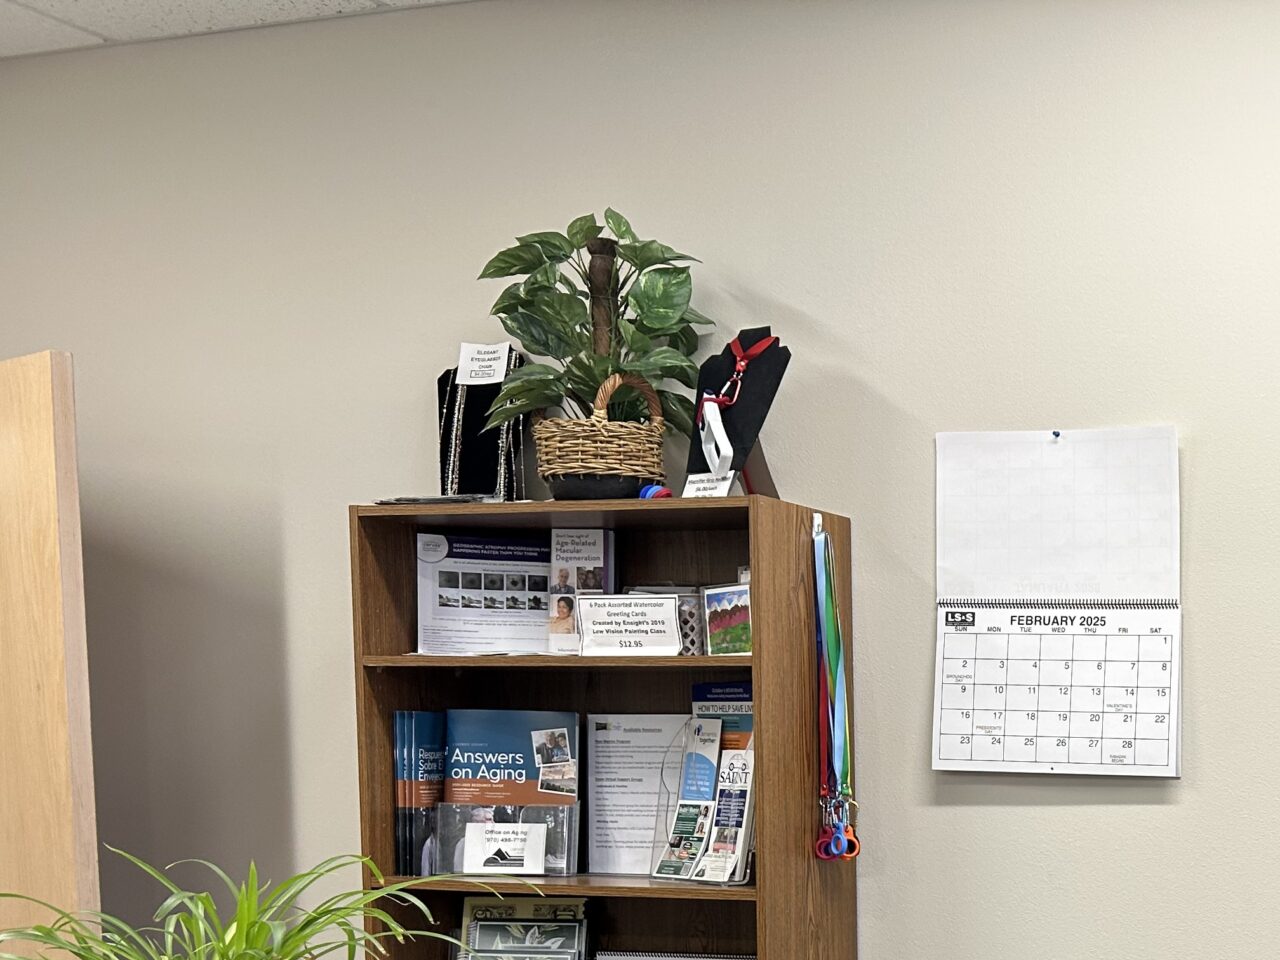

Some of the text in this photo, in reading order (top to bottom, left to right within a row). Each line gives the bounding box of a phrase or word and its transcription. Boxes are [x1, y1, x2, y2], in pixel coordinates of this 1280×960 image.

[1010, 616, 1106, 626] FEBRUARY 2025
[619, 640, 643, 648] $12.95
[1097, 662, 1102, 670] 6
[1161, 663, 1167, 671] 8
[994, 686, 1003, 694] 10
[1092, 688, 1101, 696] 13
[1090, 714, 1100, 722] 20
[1155, 715, 1165, 723] 22
[960, 736, 970, 744] 23
[1024, 738, 1034, 746] 25
[1056, 739, 1066, 747] 26
[451, 748, 524, 764] Answers
[452, 764, 525, 784] on Aging
